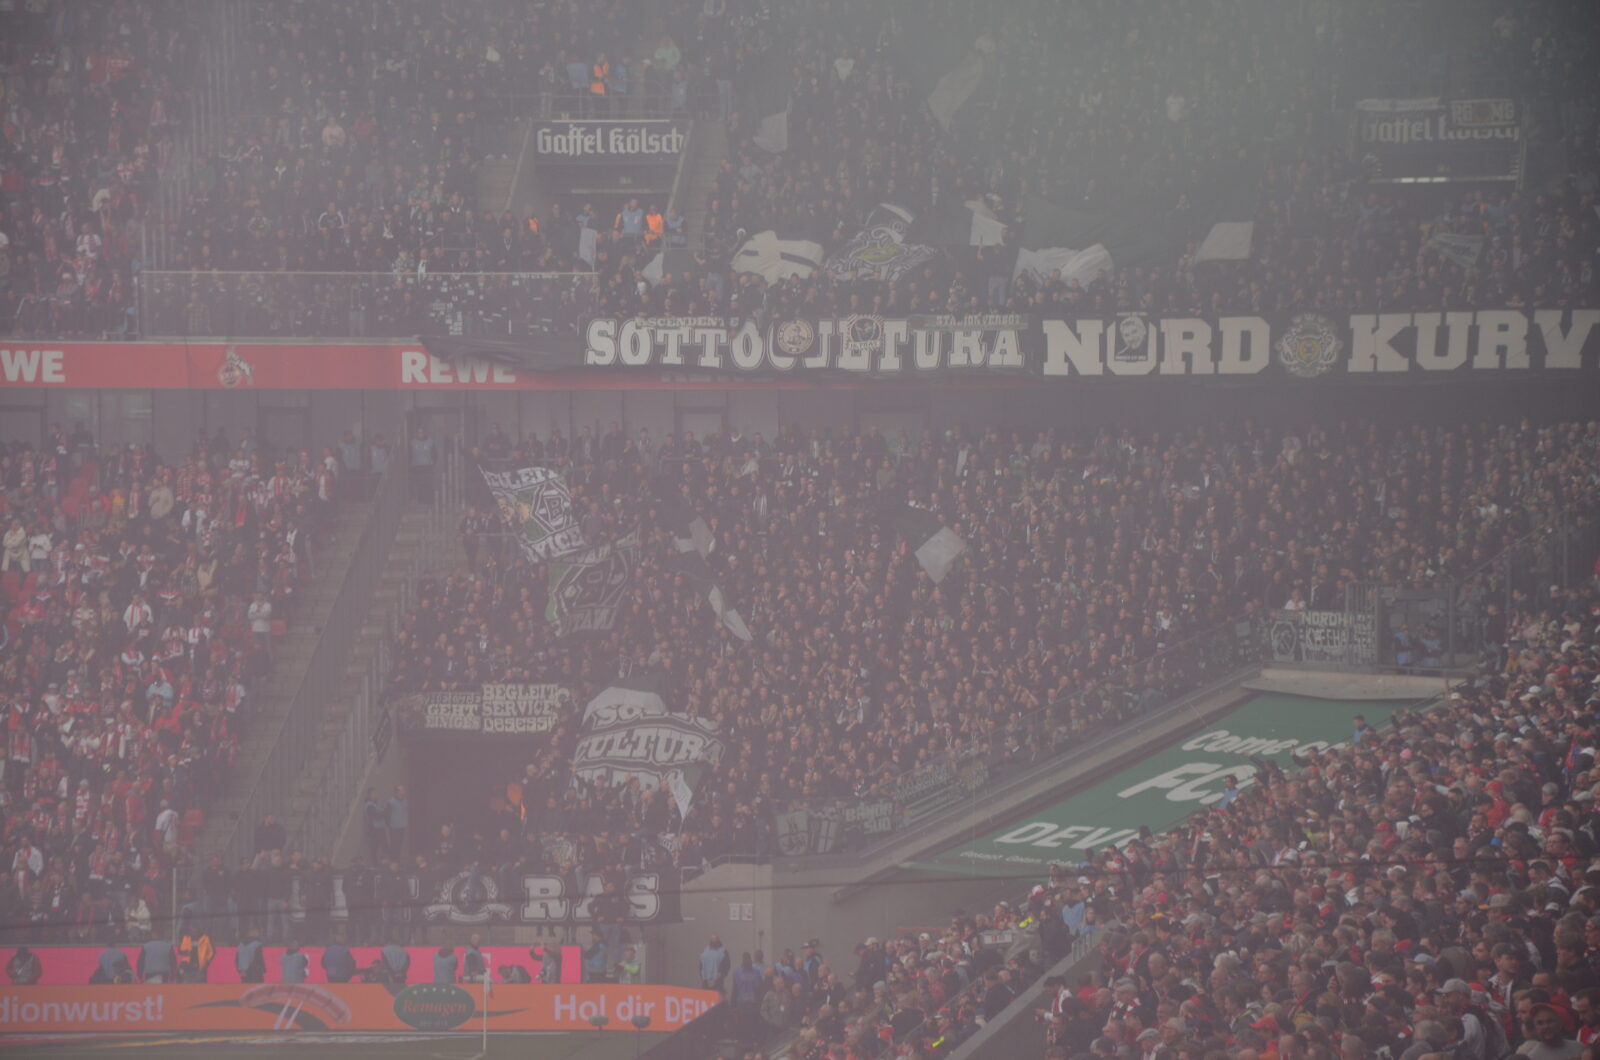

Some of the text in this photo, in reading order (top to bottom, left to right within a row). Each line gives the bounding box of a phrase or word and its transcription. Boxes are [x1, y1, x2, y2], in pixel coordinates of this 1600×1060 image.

[536, 123, 684, 157] Gaffel Kölsch
[1042, 316, 1271, 376] NORD
[481, 683, 559, 699] BEGLEIT
[482, 699, 555, 716] SERVICE
[1182, 730, 1298, 755] Come
[993, 822, 1140, 850] DEV
[554, 994, 606, 1022] Hol
[616, 993, 655, 1022] dir
